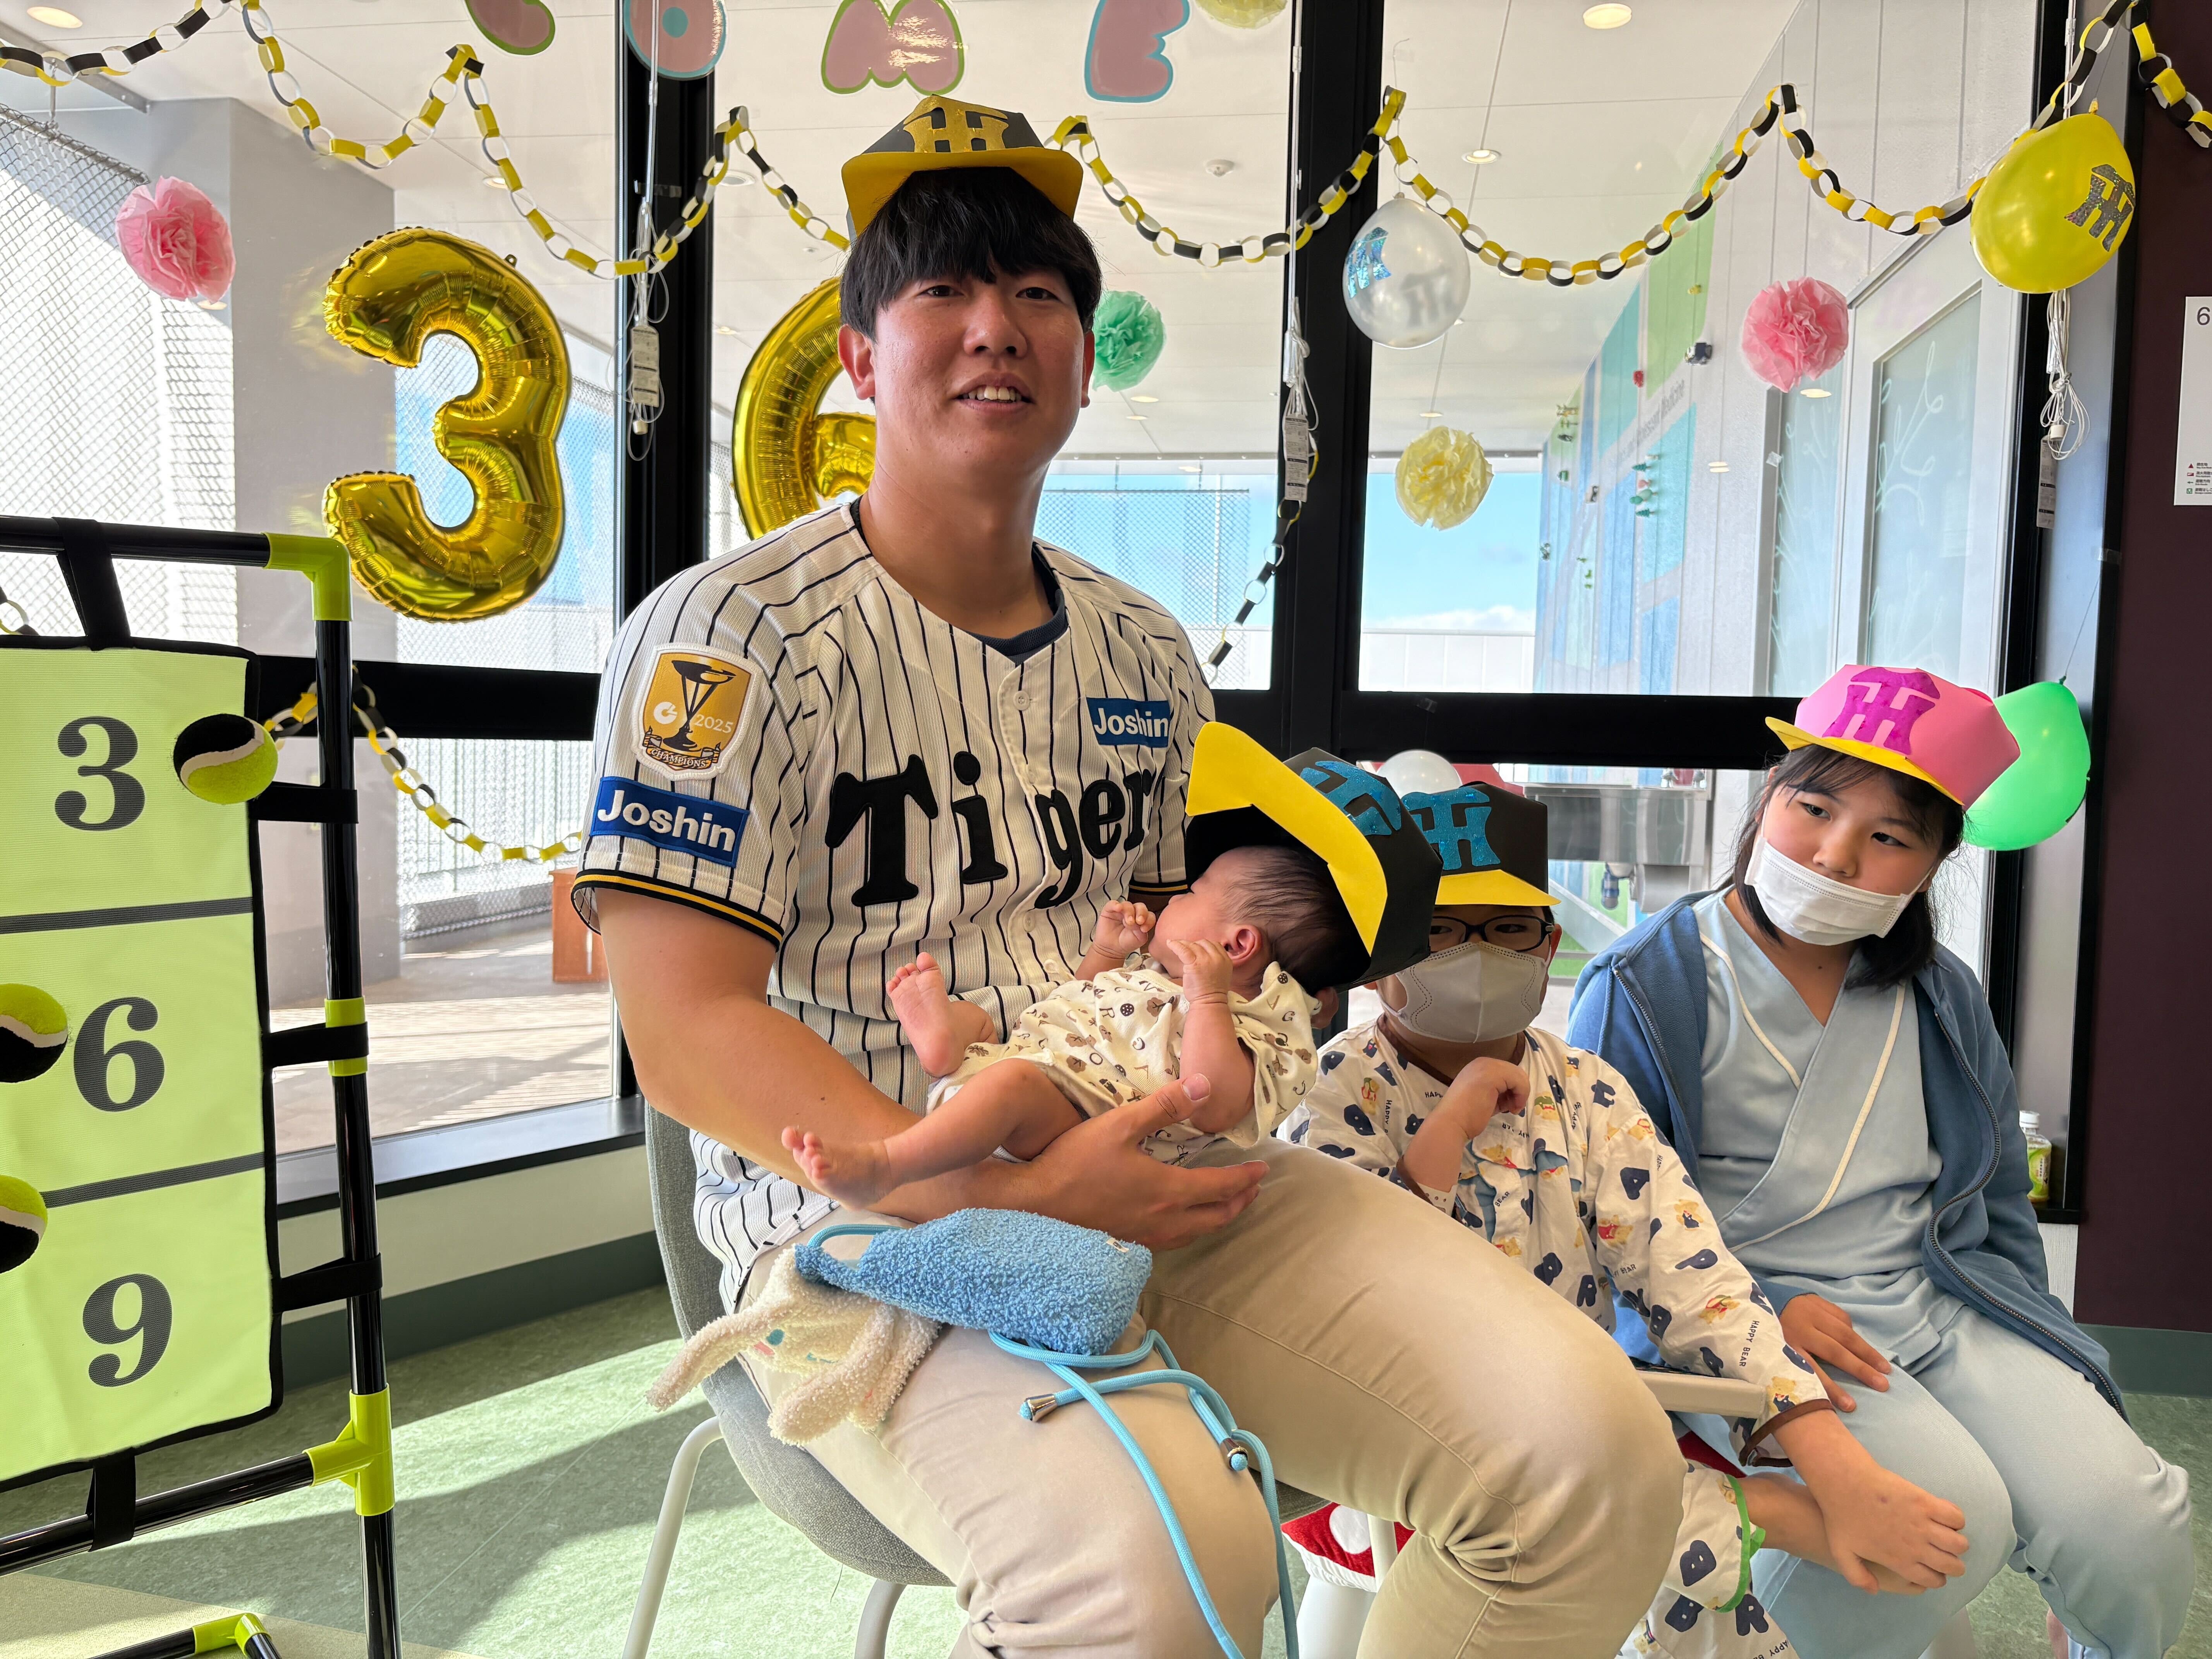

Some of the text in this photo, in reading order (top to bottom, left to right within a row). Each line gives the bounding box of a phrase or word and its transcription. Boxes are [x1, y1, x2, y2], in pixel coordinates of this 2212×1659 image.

[322, 226, 572, 622] 3
[694, 714, 733, 734] 2025
[1094, 708, 1168, 737] Joshin
[55, 716, 145, 831] 3
[651, 749, 707, 768] CHAMPIONS
[598, 790, 735, 852] Joshin
[825, 751, 1154, 909] Tiger
[73, 996, 165, 1112] 6
[1495, 1191, 1510, 1207] BEAR
[82, 1273, 173, 1387] 9
[1739, 1320, 1760, 1367] HAPPY BEAR
